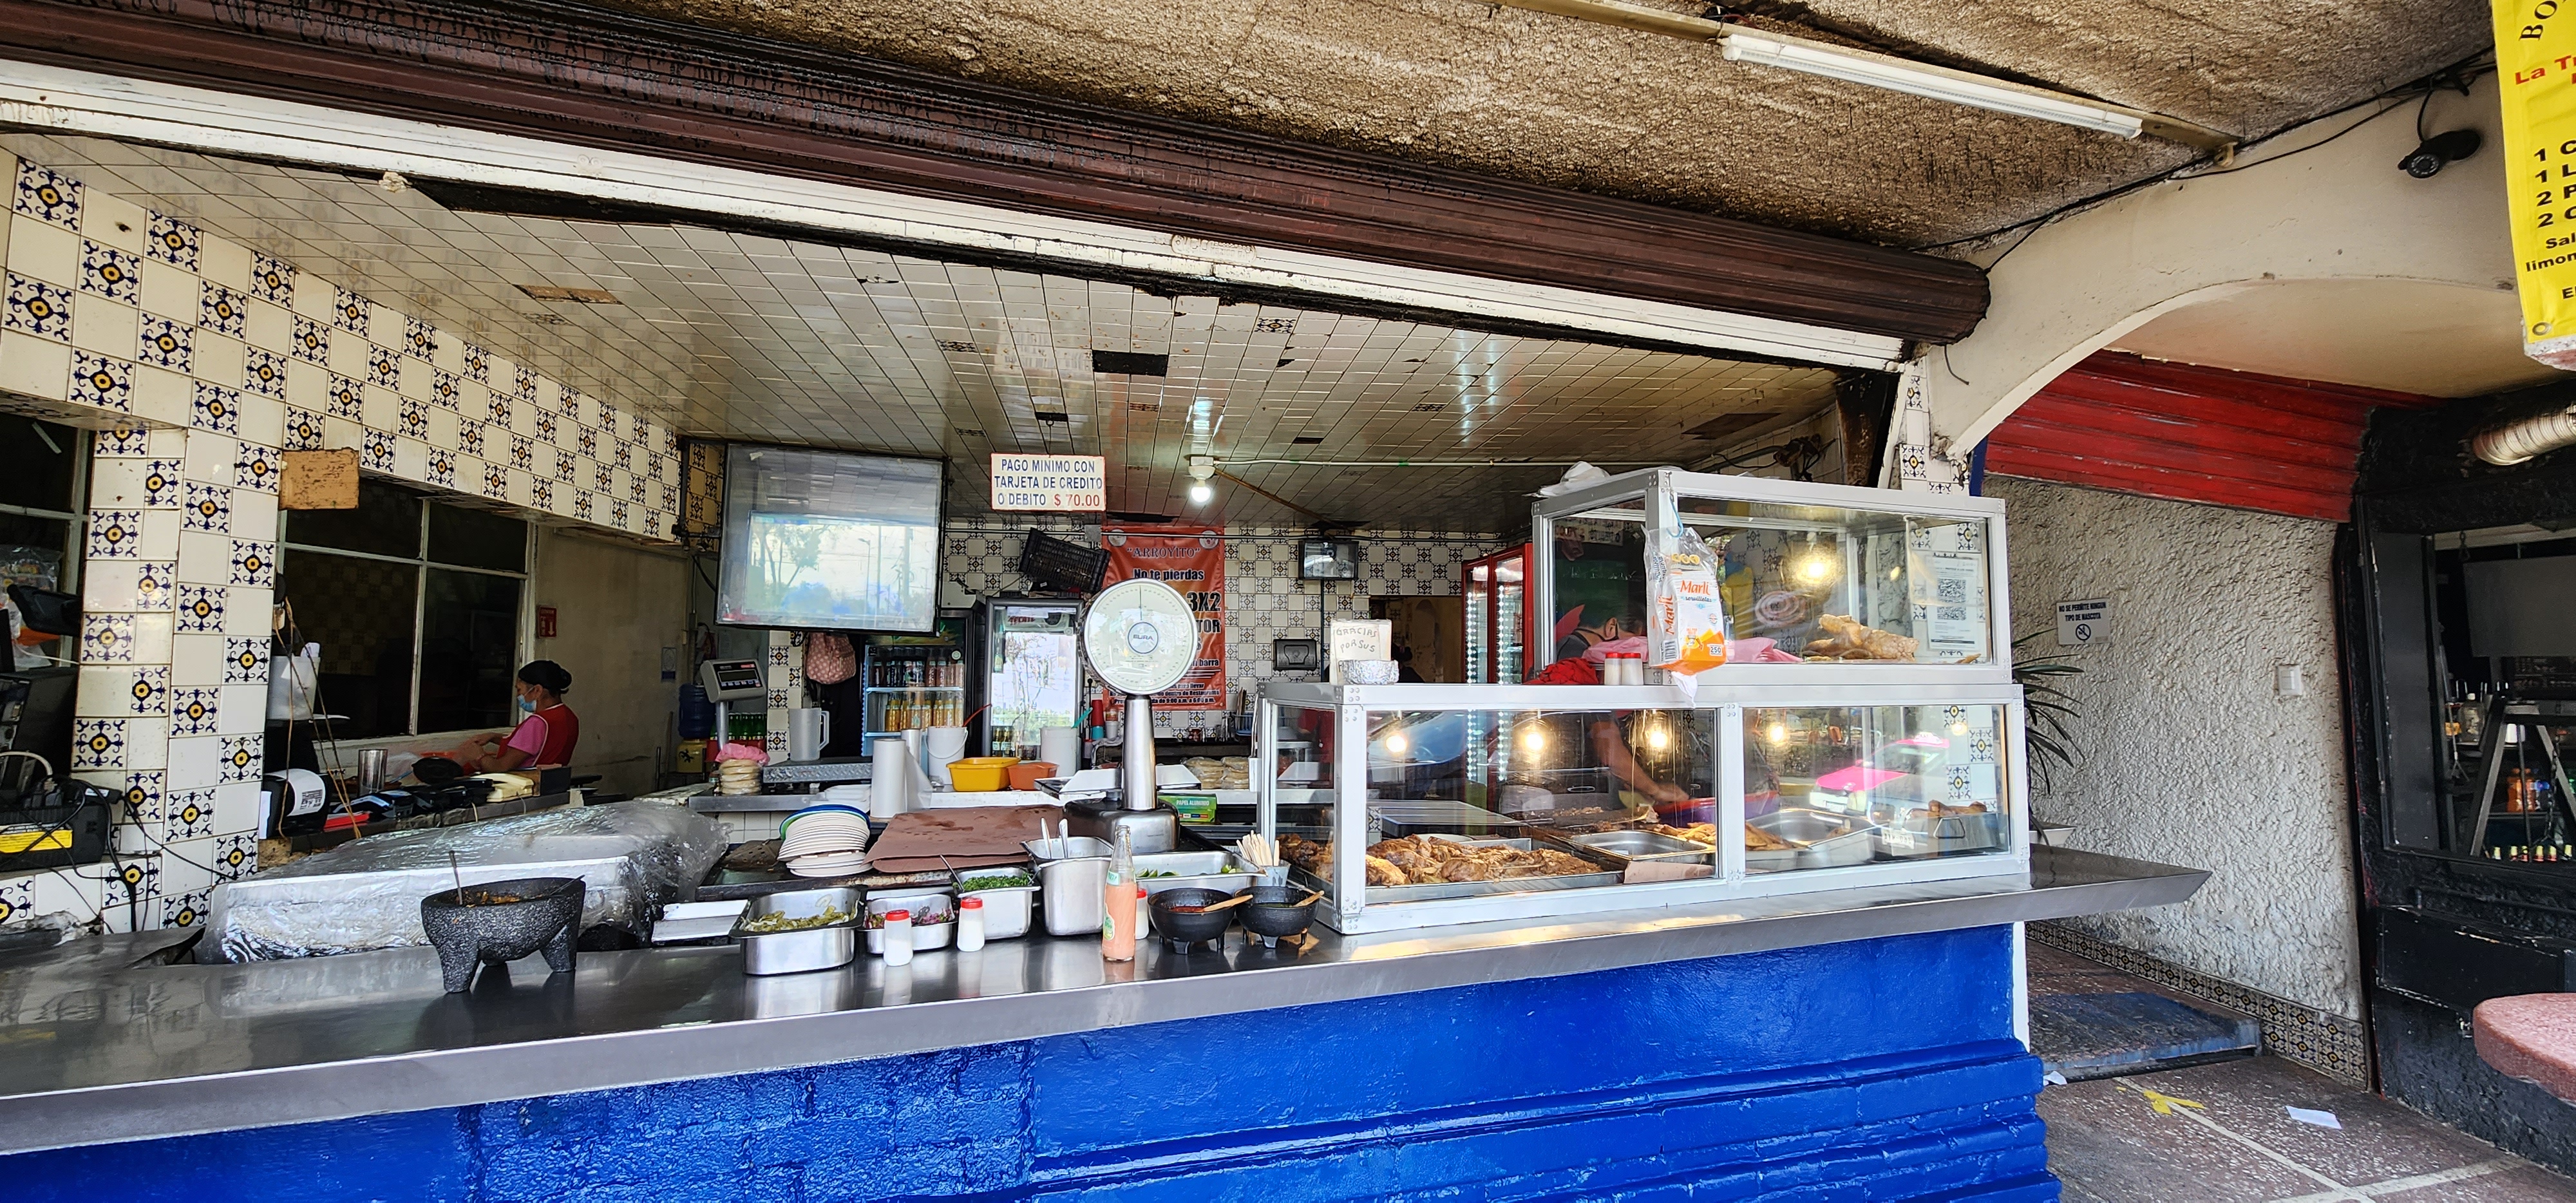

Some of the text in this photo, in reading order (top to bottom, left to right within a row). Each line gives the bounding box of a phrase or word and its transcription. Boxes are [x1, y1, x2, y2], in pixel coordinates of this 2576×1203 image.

[2519, 0, 2558, 41] BO
[2515, 68, 2546, 85] La
[2534, 147, 2546, 162] 1
[2535, 169, 2547, 184] 1
[2536, 190, 2552, 207] 2
[2537, 212, 2554, 228] 2
[1001, 459, 1095, 473] PAGO MINIMO CON
[994, 475, 1103, 489] TARJETA DE CREDITO
[1009, 493, 1046, 506] DEBITO
[1054, 493, 1061, 507] $
[1066, 494, 1100, 506] 70.00
[1134, 569, 1204, 581] No te pierdas
[1680, 580, 1710, 596] Marli
[1658, 594, 1674, 636] Marli
[1336, 628, 1377, 638] GRACIAS
